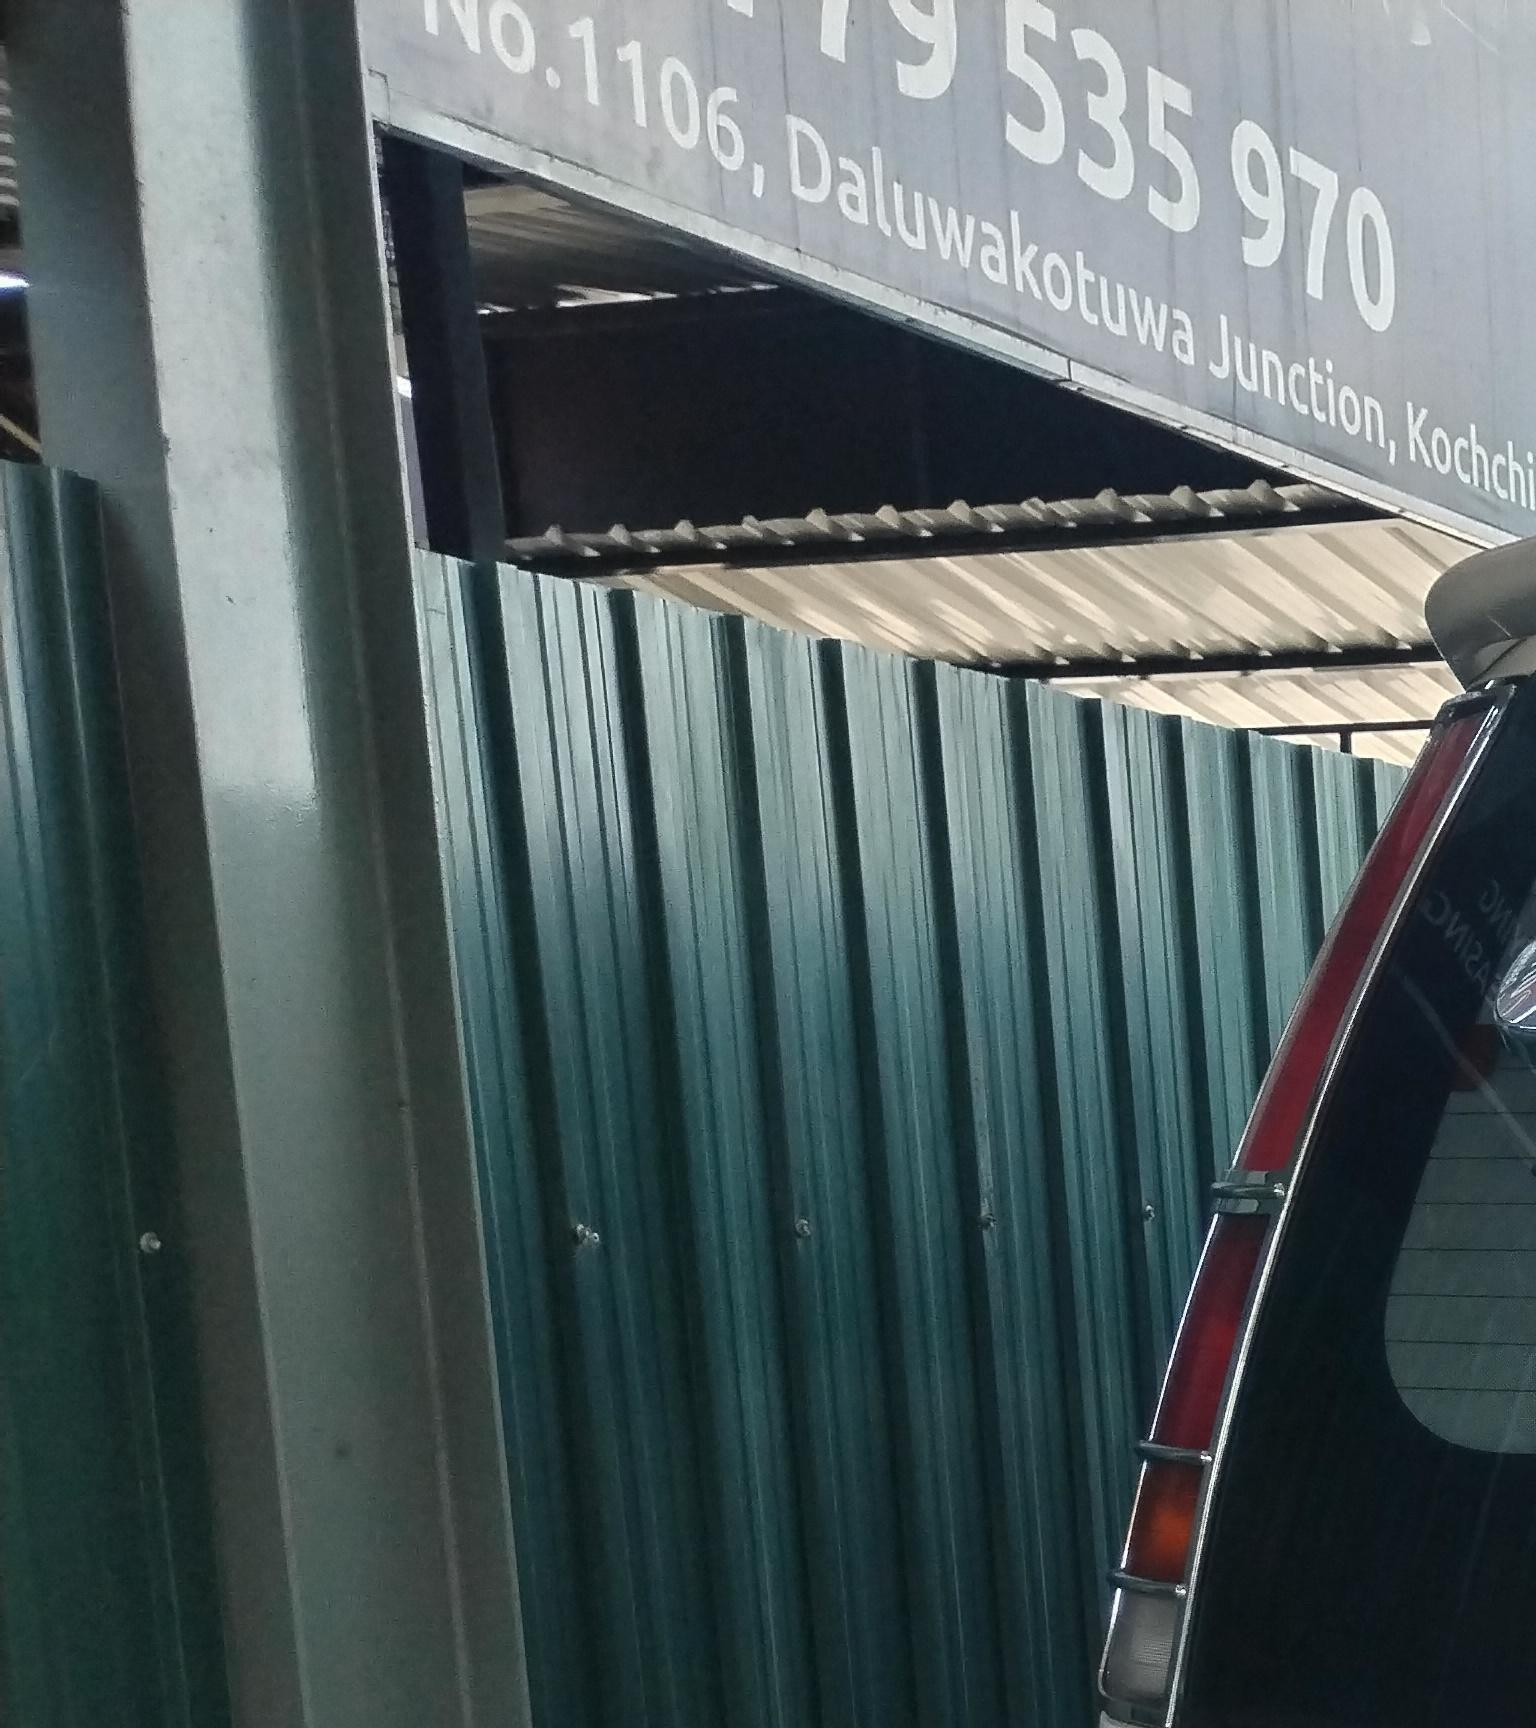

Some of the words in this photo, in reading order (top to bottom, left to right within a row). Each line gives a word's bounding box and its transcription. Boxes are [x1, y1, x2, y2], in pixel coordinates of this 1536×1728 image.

[786, 114, 1195, 367] Daluwakotuwa
[1208, 313, 1398, 465] Junction,
[1002, 0, 1201, 233] 535
[1230, 119, 1397, 332] 970
